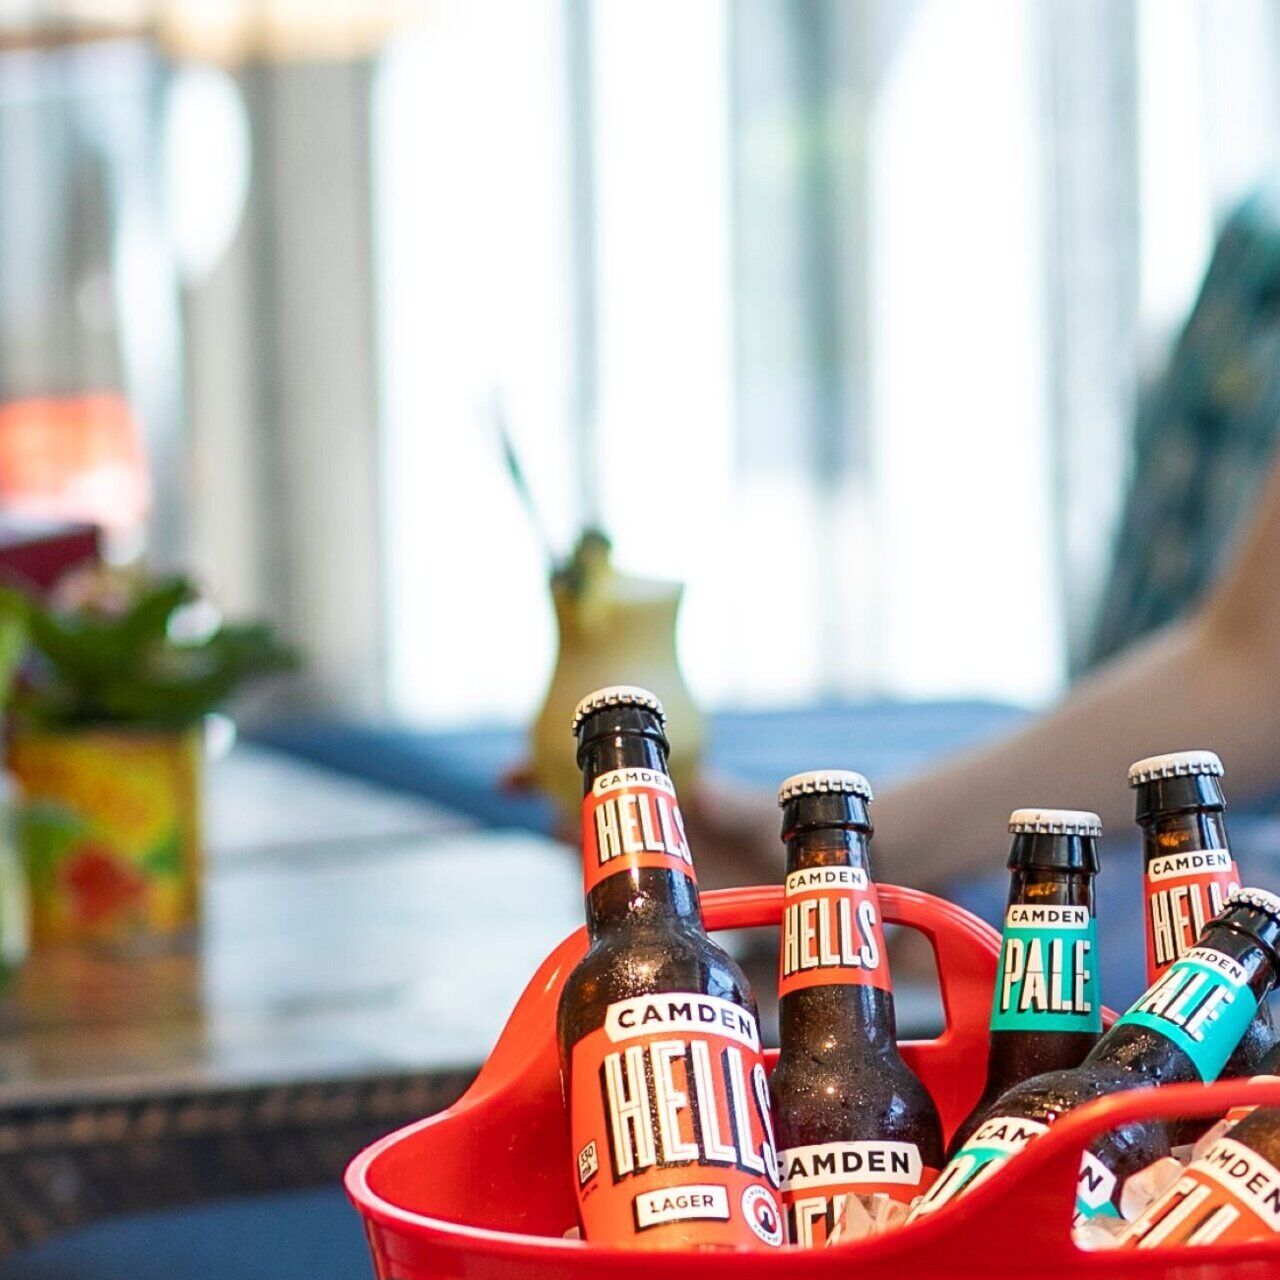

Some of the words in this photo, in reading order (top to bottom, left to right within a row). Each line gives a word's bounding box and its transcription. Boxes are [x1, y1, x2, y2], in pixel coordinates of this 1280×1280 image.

[599, 772, 671, 790] CAMDEN
[1153, 855, 1227, 875] CAMDEN
[788, 871, 861, 890] CAMDEN
[1011, 910, 1085, 922] CAMDEN
[783, 897, 880, 976] HELLS
[1001, 937, 1092, 1013] PALE
[617, 1002, 753, 1040] CAMDEN
[601, 1040, 780, 1189] HELLS
[648, 1194, 716, 1216] LAGER
